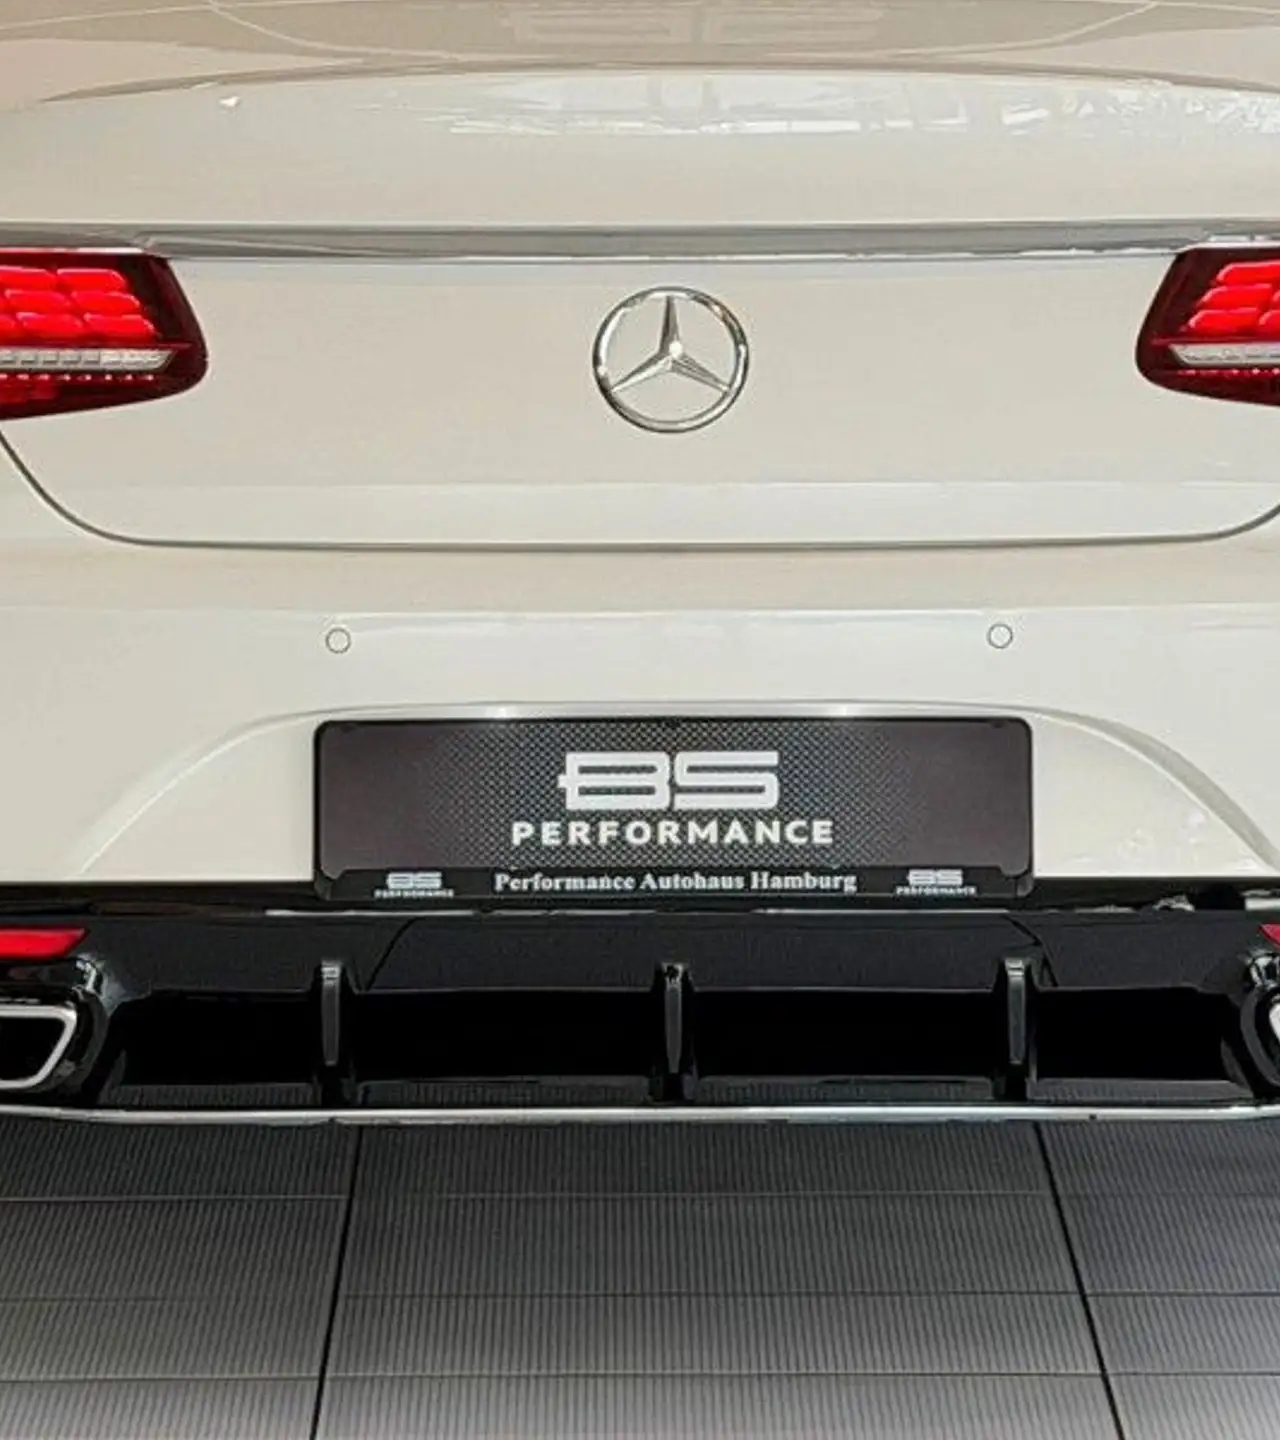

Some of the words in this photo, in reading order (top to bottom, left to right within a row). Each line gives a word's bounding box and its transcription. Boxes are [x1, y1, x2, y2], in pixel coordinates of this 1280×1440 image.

[557, 750, 780, 811] BS
[511, 819, 835, 848] PERFORMANCE
[494, 871, 636, 892] Performance
[639, 871, 745, 891] Autohaus
[750, 871, 858, 895] Hamburg
